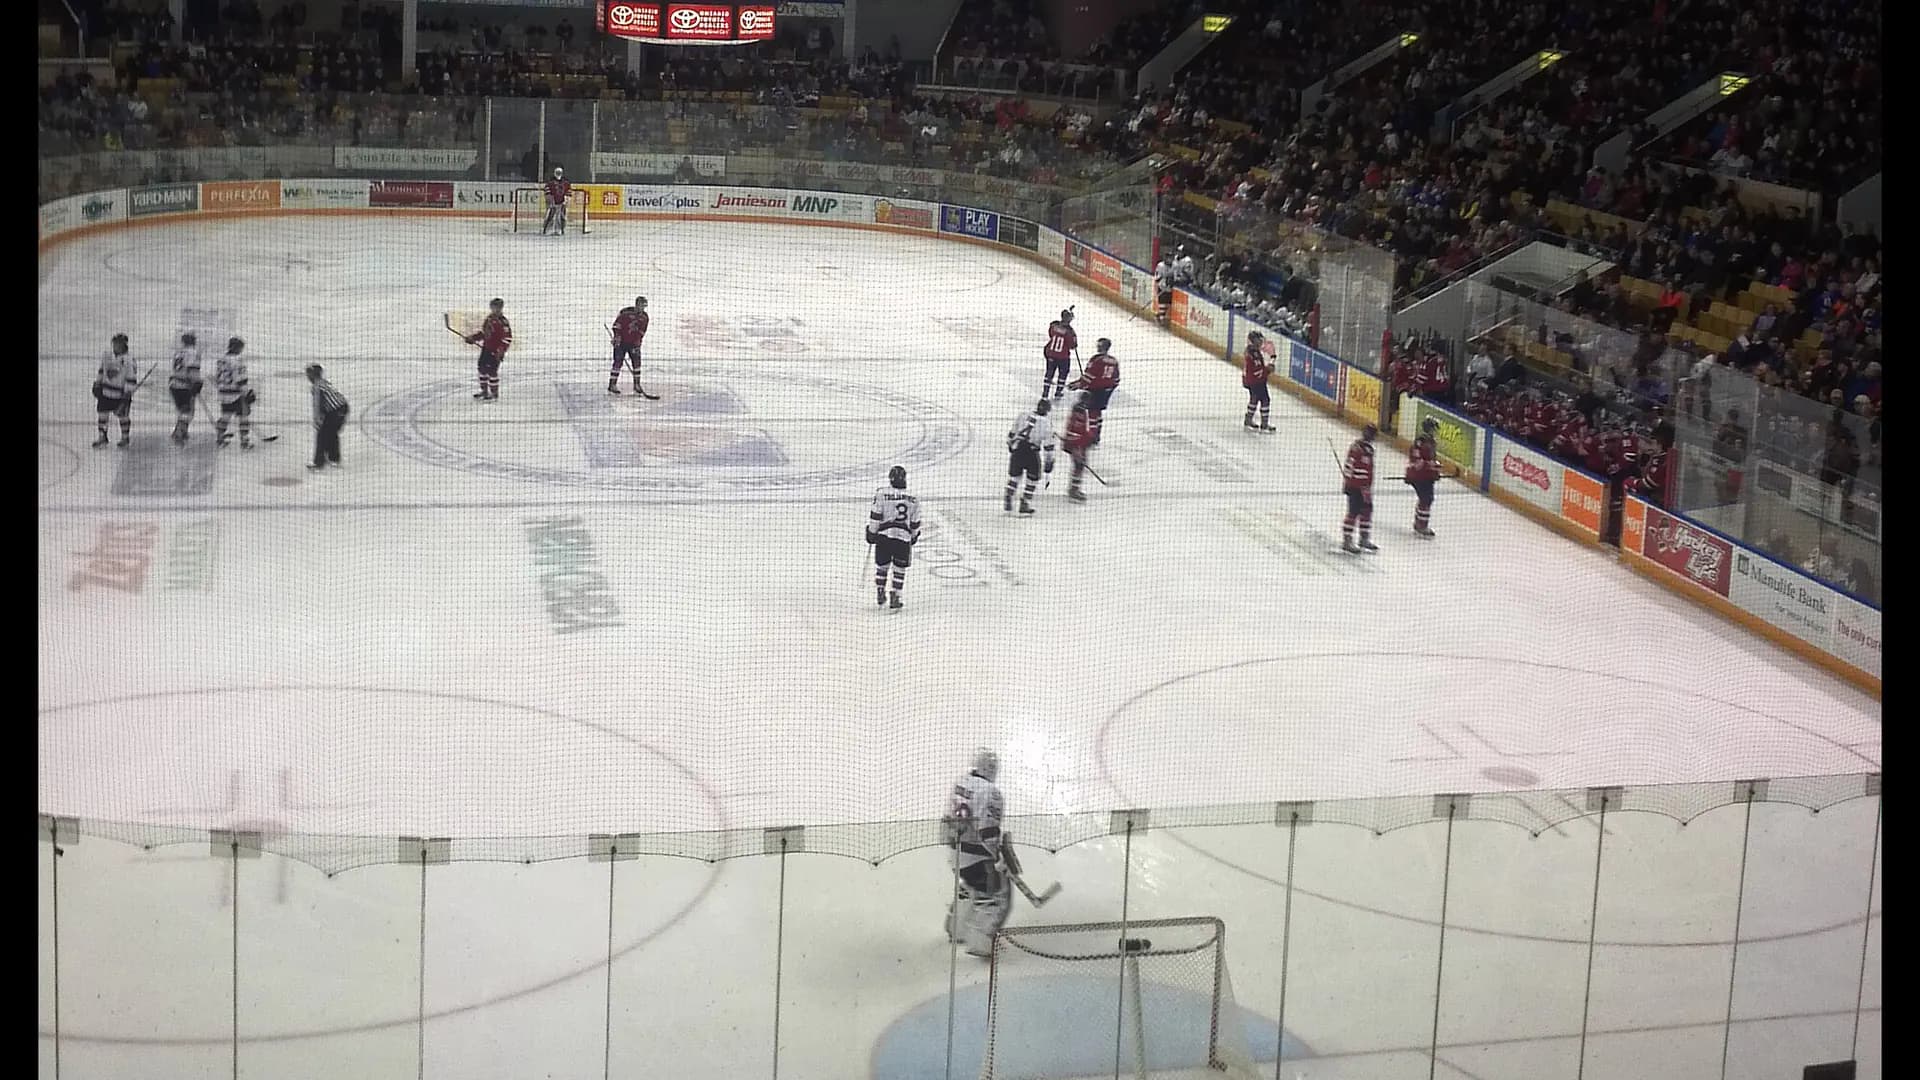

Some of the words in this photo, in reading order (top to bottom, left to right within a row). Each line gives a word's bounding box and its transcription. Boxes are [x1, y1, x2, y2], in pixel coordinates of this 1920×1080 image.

[474, 190, 505, 204] Sun
[628, 195, 663, 207] travel
[676, 196, 700, 208] plus
[711, 193, 787, 209] Jamieson
[792, 195, 838, 214] MNP
[965, 210, 990, 226] PLAY
[1050, 335, 1065, 353] 10
[895, 503, 908, 521] 3
[1674, 523, 1725, 563] Hockey
[1751, 564, 1797, 600] Manulife
[1798, 587, 1827, 614] Bank
